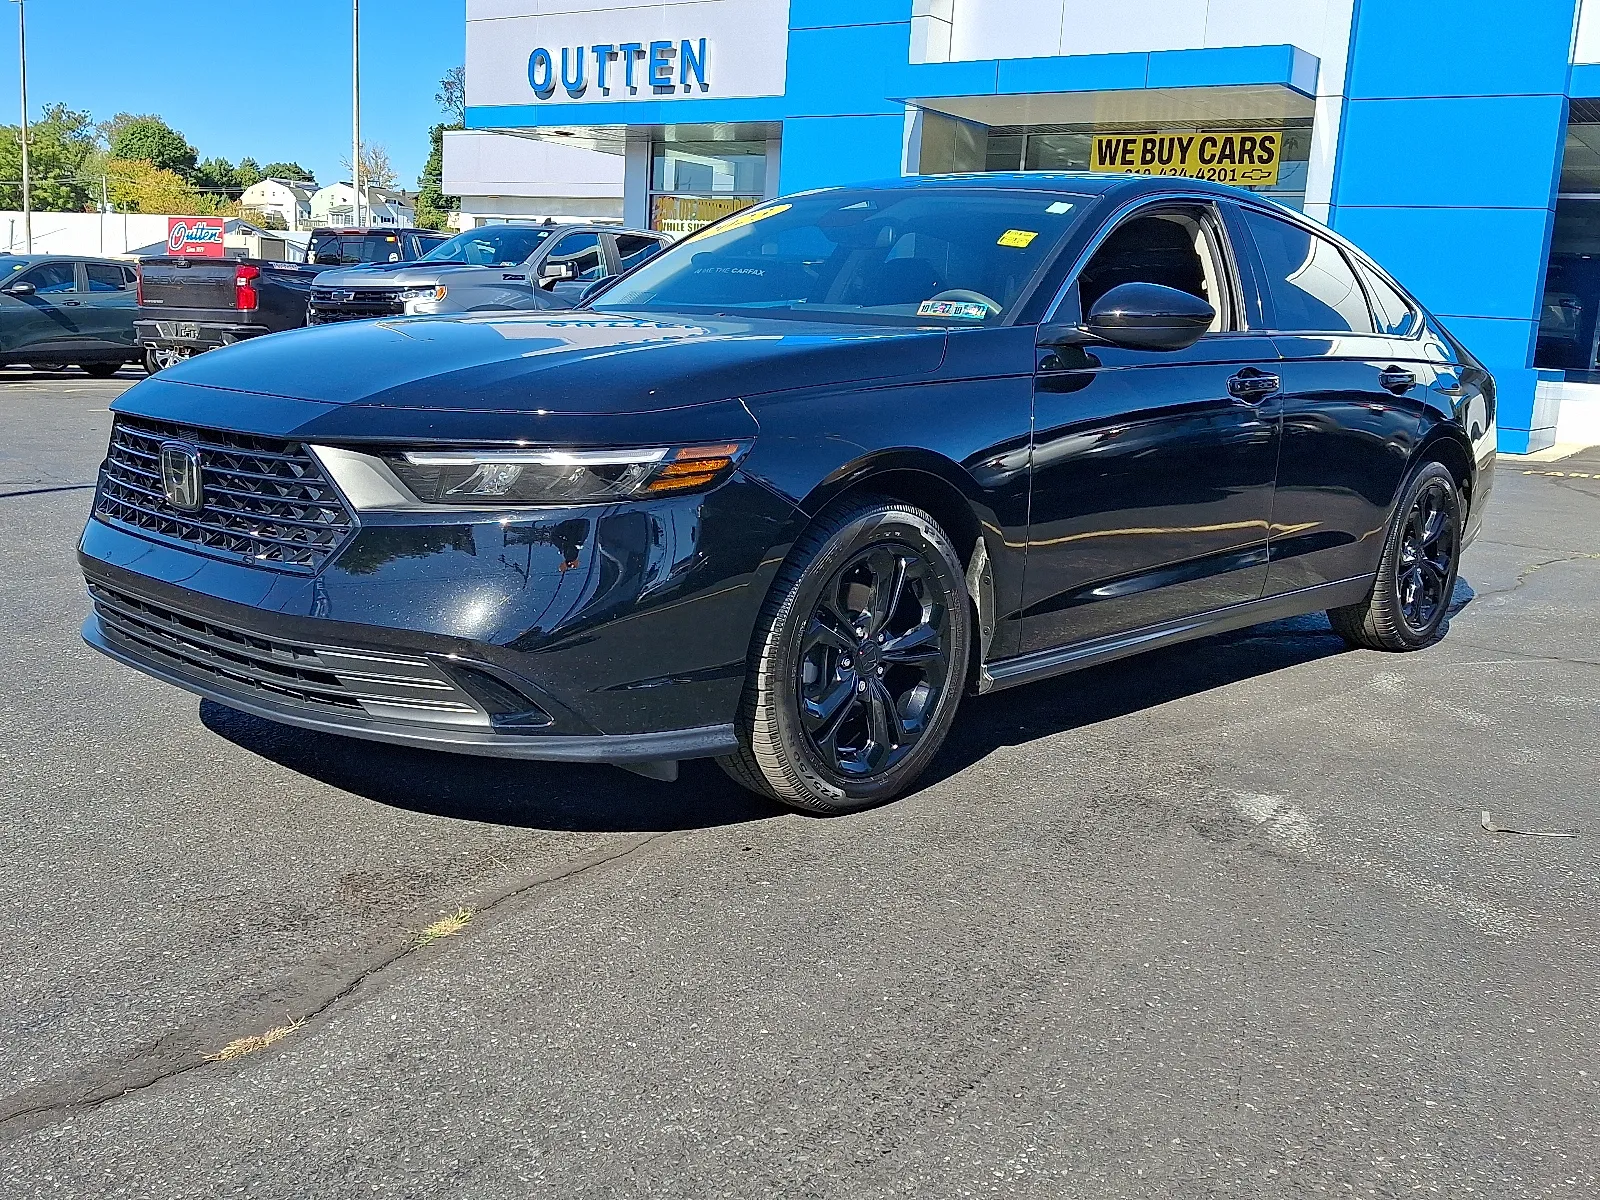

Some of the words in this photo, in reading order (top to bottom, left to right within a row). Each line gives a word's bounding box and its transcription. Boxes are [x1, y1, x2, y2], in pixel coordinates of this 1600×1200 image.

[527, 37, 709, 96] OUTTEN
[1097, 138, 1137, 166] WE
[1140, 136, 1195, 166] BUY
[1198, 135, 1276, 166] CARS
[169, 221, 222, 251] Outten
[731, 267, 766, 277] CARFAX
